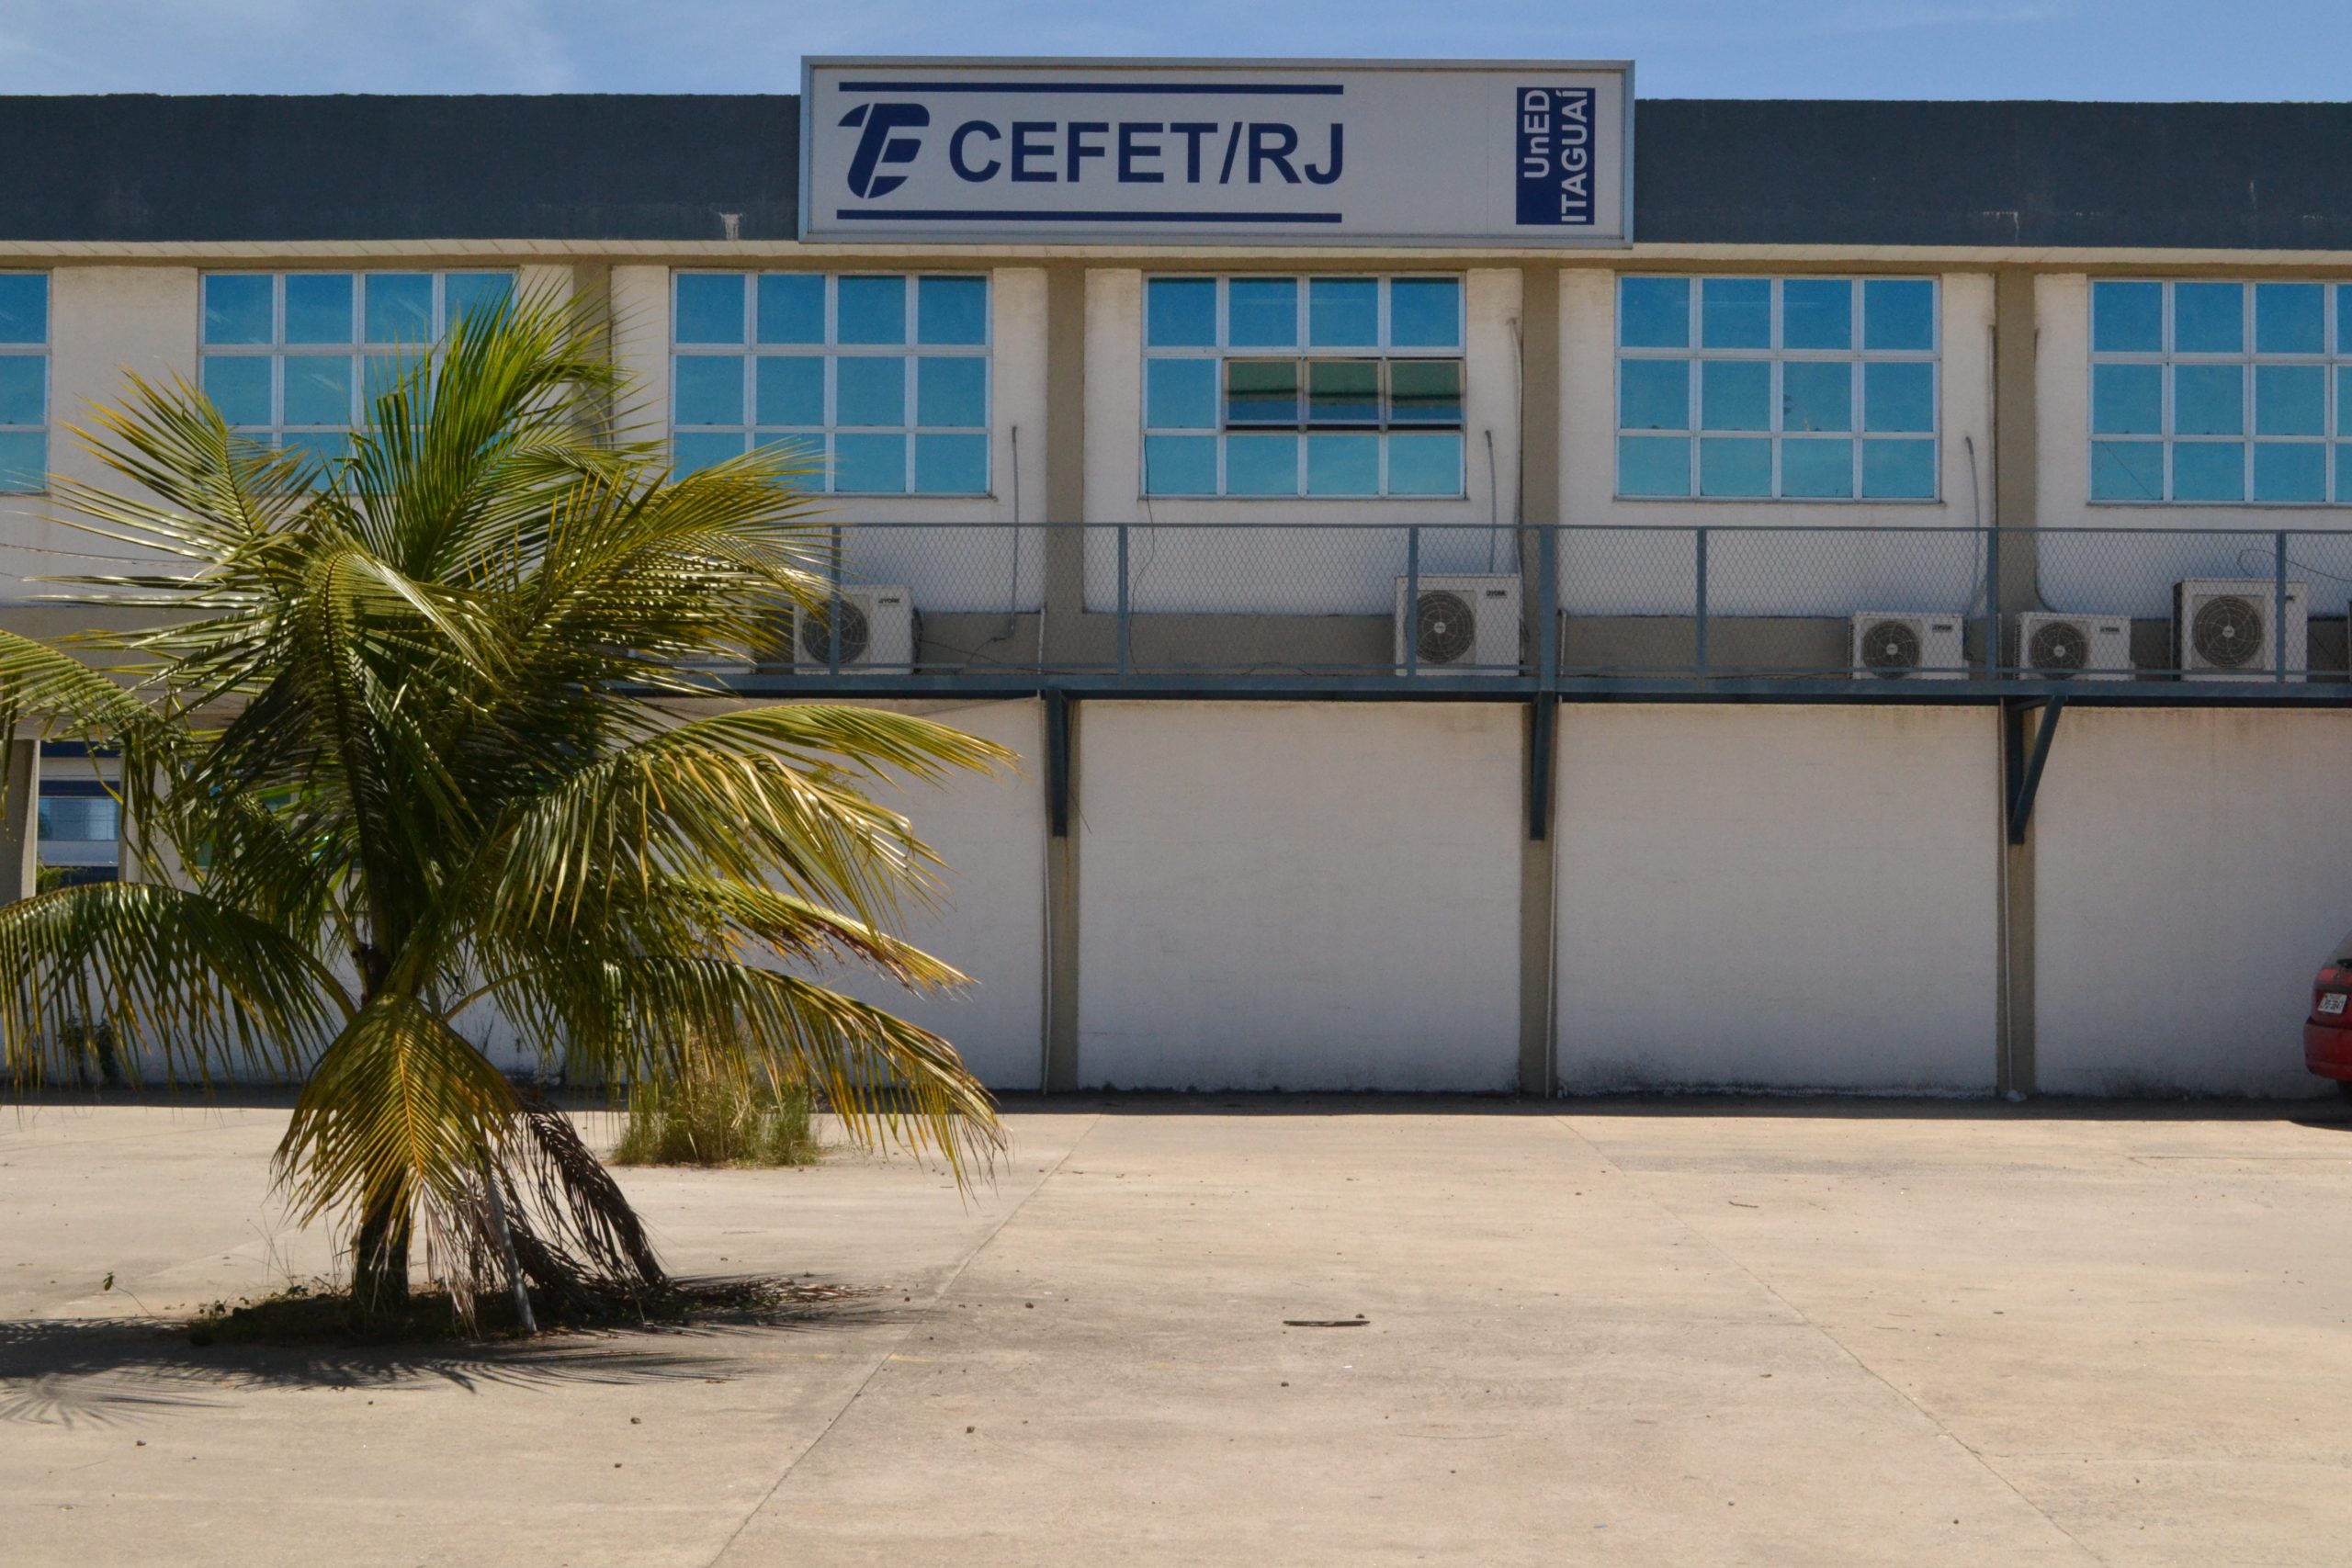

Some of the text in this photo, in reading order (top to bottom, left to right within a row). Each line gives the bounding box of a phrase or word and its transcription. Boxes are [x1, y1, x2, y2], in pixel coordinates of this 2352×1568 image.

[949, 119, 1343, 185] CEFET/RJ
[1523, 89, 1550, 178] UnED
[1555, 89, 1588, 222] ITAGUAÍ
